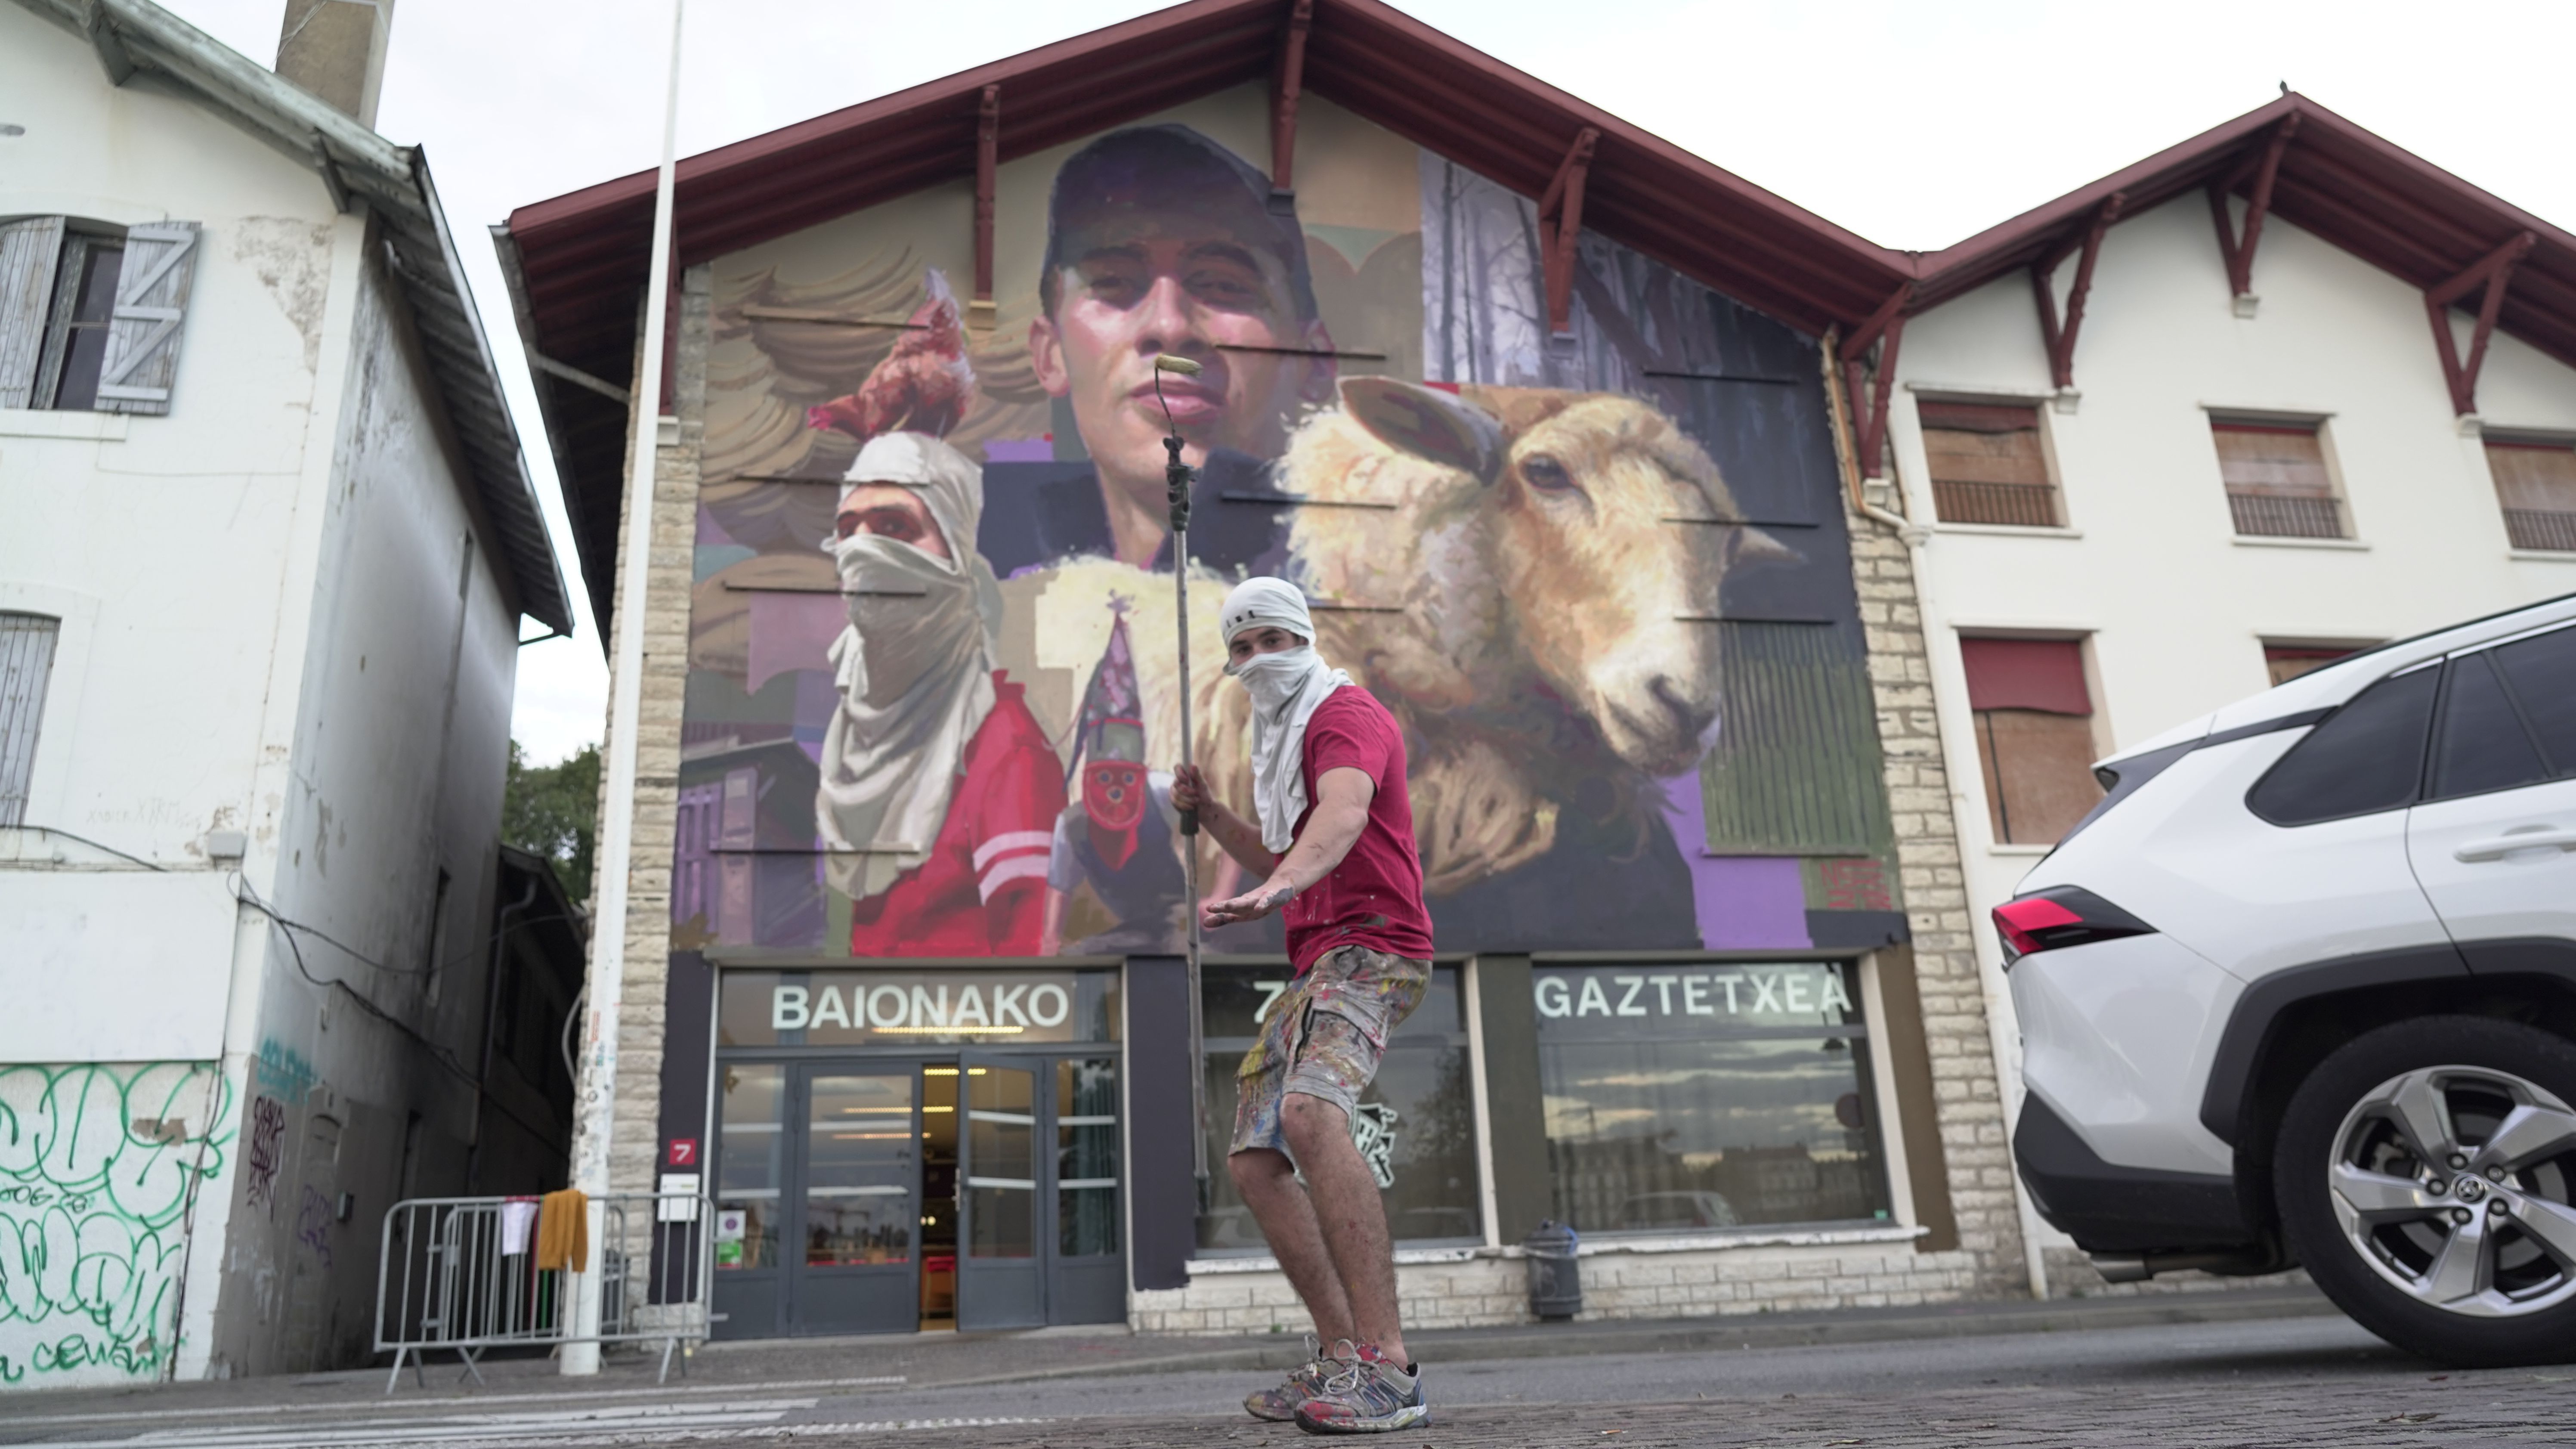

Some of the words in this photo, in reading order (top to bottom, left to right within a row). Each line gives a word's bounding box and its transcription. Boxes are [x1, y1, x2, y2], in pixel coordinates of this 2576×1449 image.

[772, 984, 1069, 1029] BAIONAKO
[1534, 974, 1852, 1017] GAZTETXEA
[674, 1143, 691, 1162] 7
